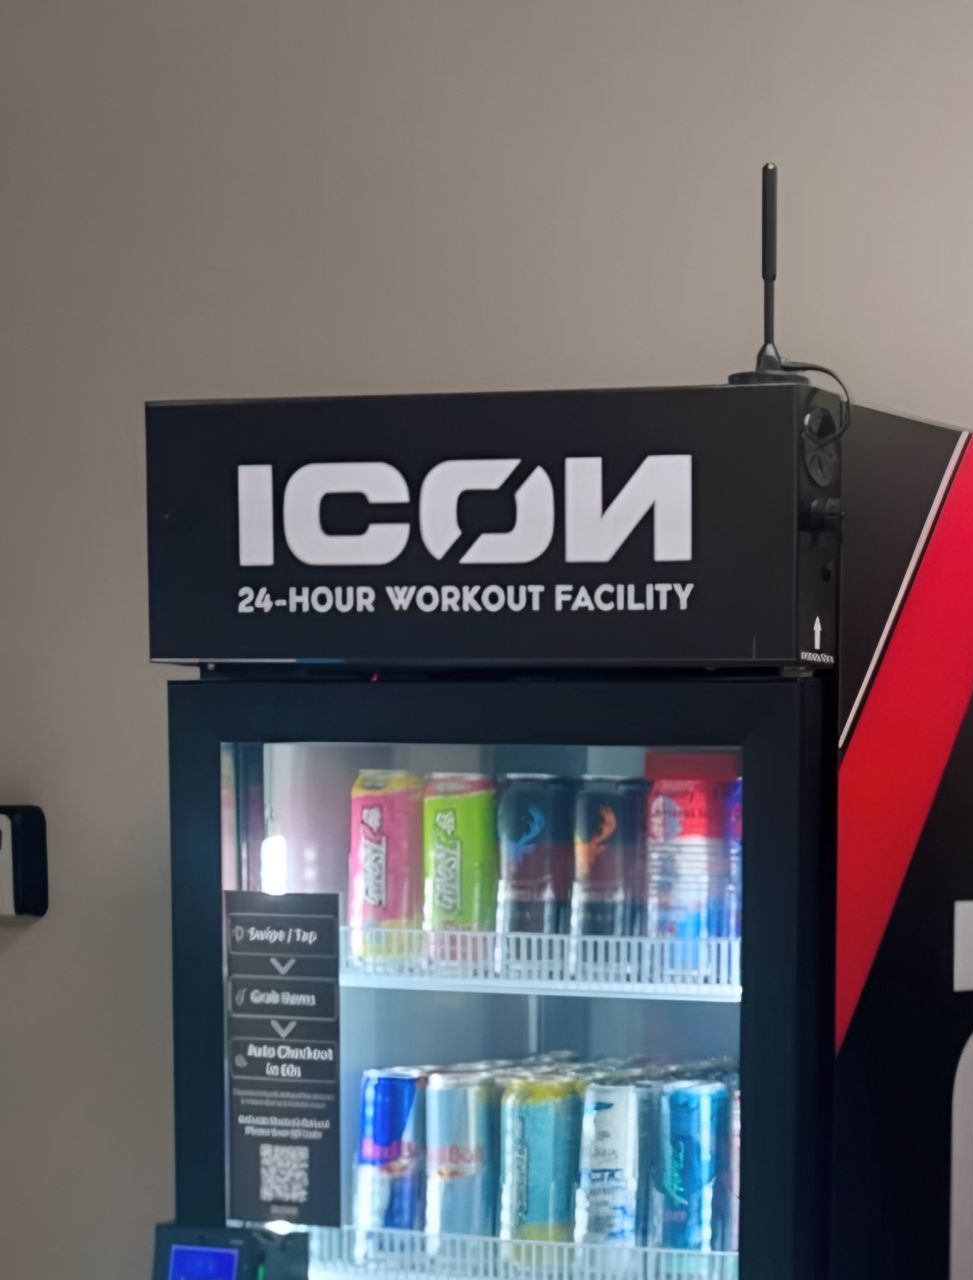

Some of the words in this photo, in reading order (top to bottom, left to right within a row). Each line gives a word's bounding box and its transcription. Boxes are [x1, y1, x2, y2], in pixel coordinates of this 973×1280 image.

[237, 453, 693, 567] ICON
[237, 586, 376, 613] 24-HOUR
[385, 584, 545, 612] WORKOUT
[554, 583, 694, 612] FACILITY
